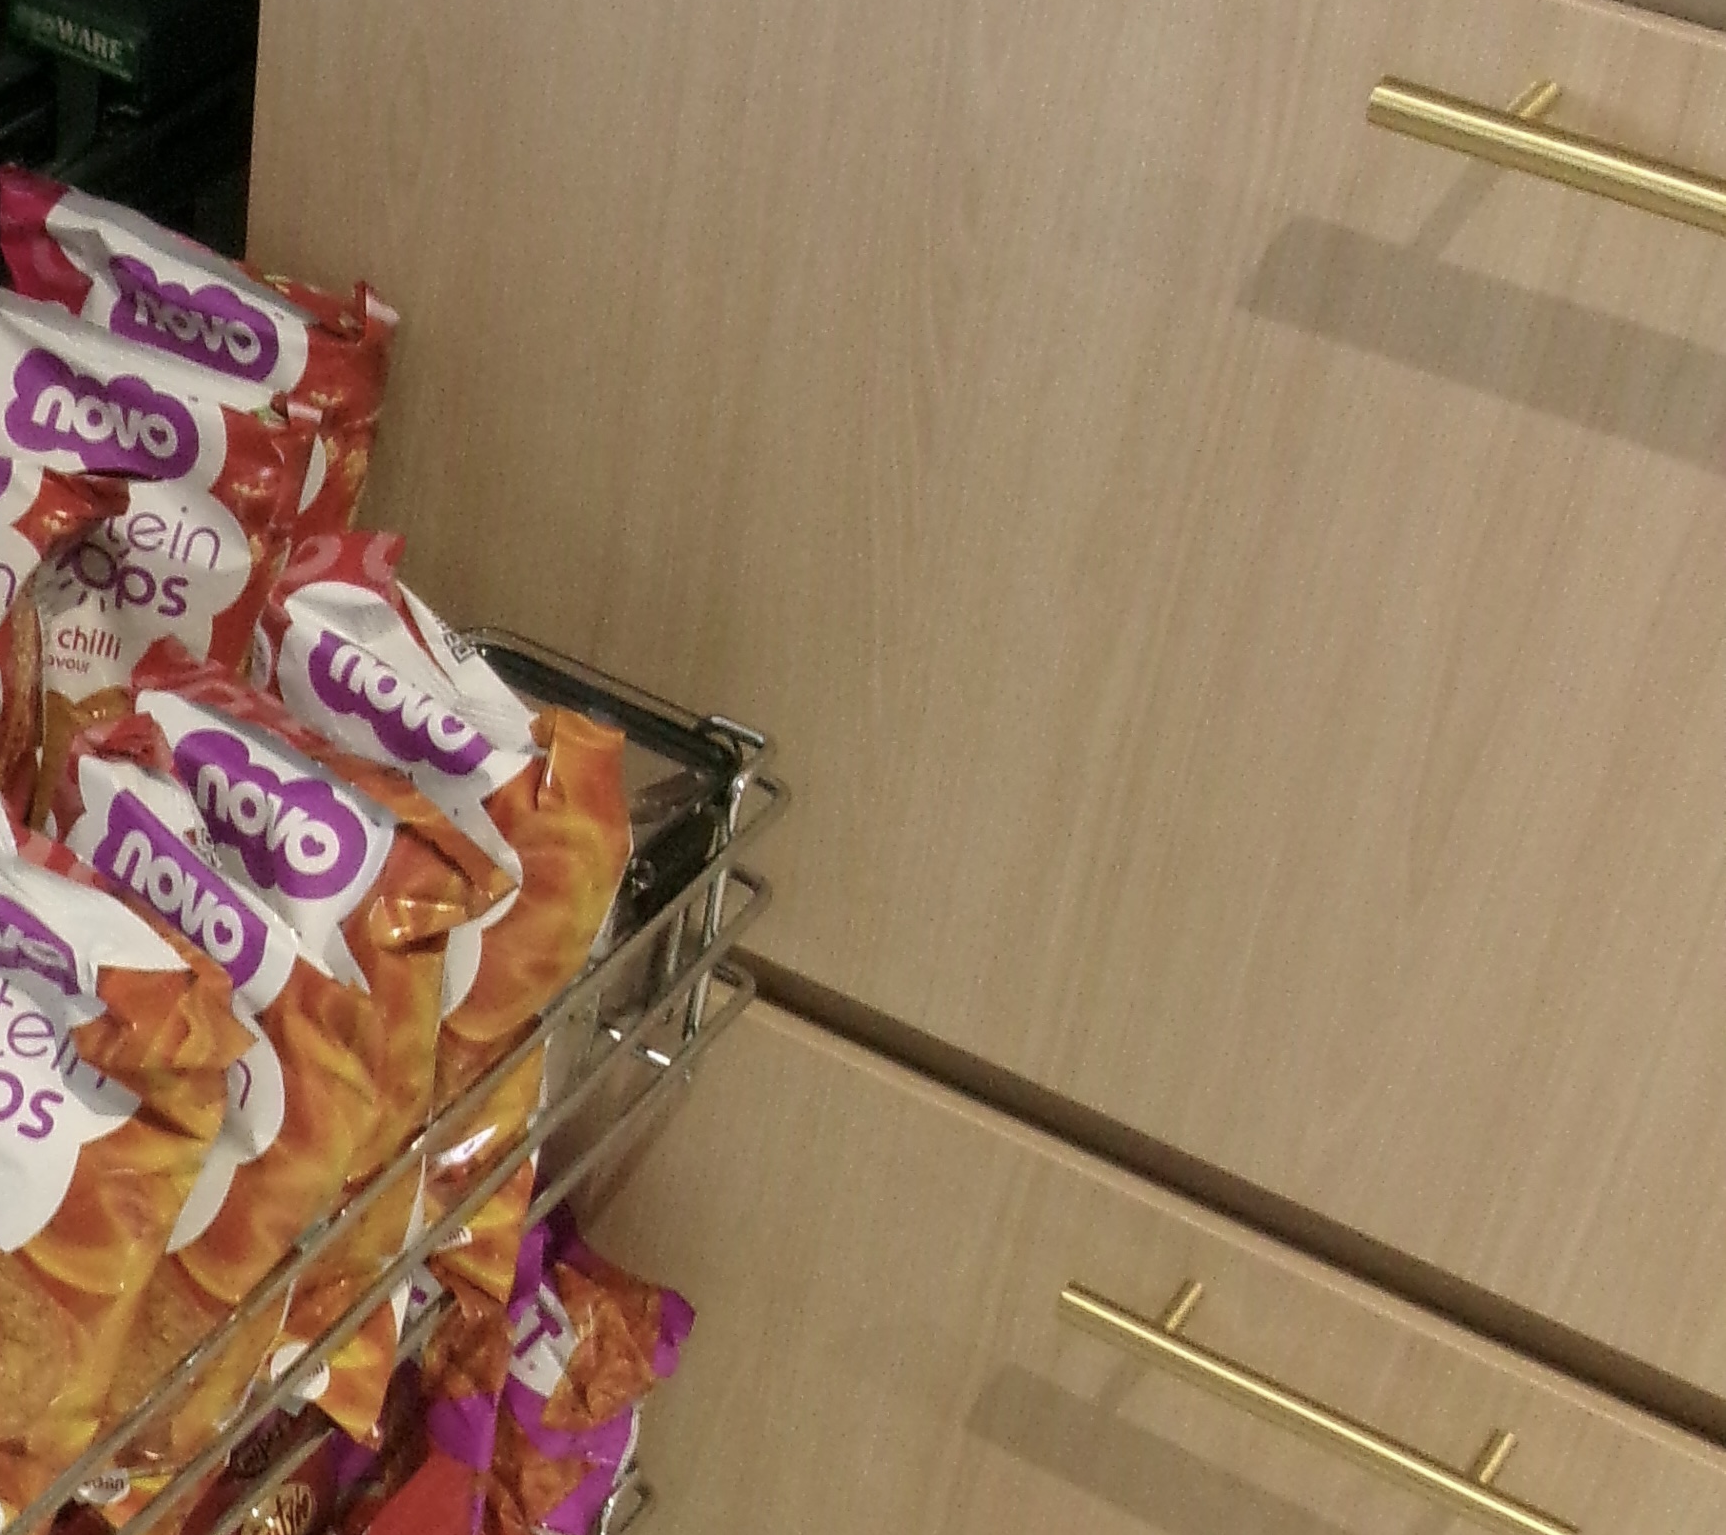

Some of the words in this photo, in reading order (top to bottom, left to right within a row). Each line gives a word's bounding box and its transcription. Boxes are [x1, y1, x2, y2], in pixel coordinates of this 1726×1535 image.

[134, 294, 264, 365] novo
[33, 386, 179, 459] novo
[57, 625, 122, 662] chilli
[327, 641, 473, 753] novo
[197, 763, 341, 874] novo
[112, 829, 245, 963] novo
